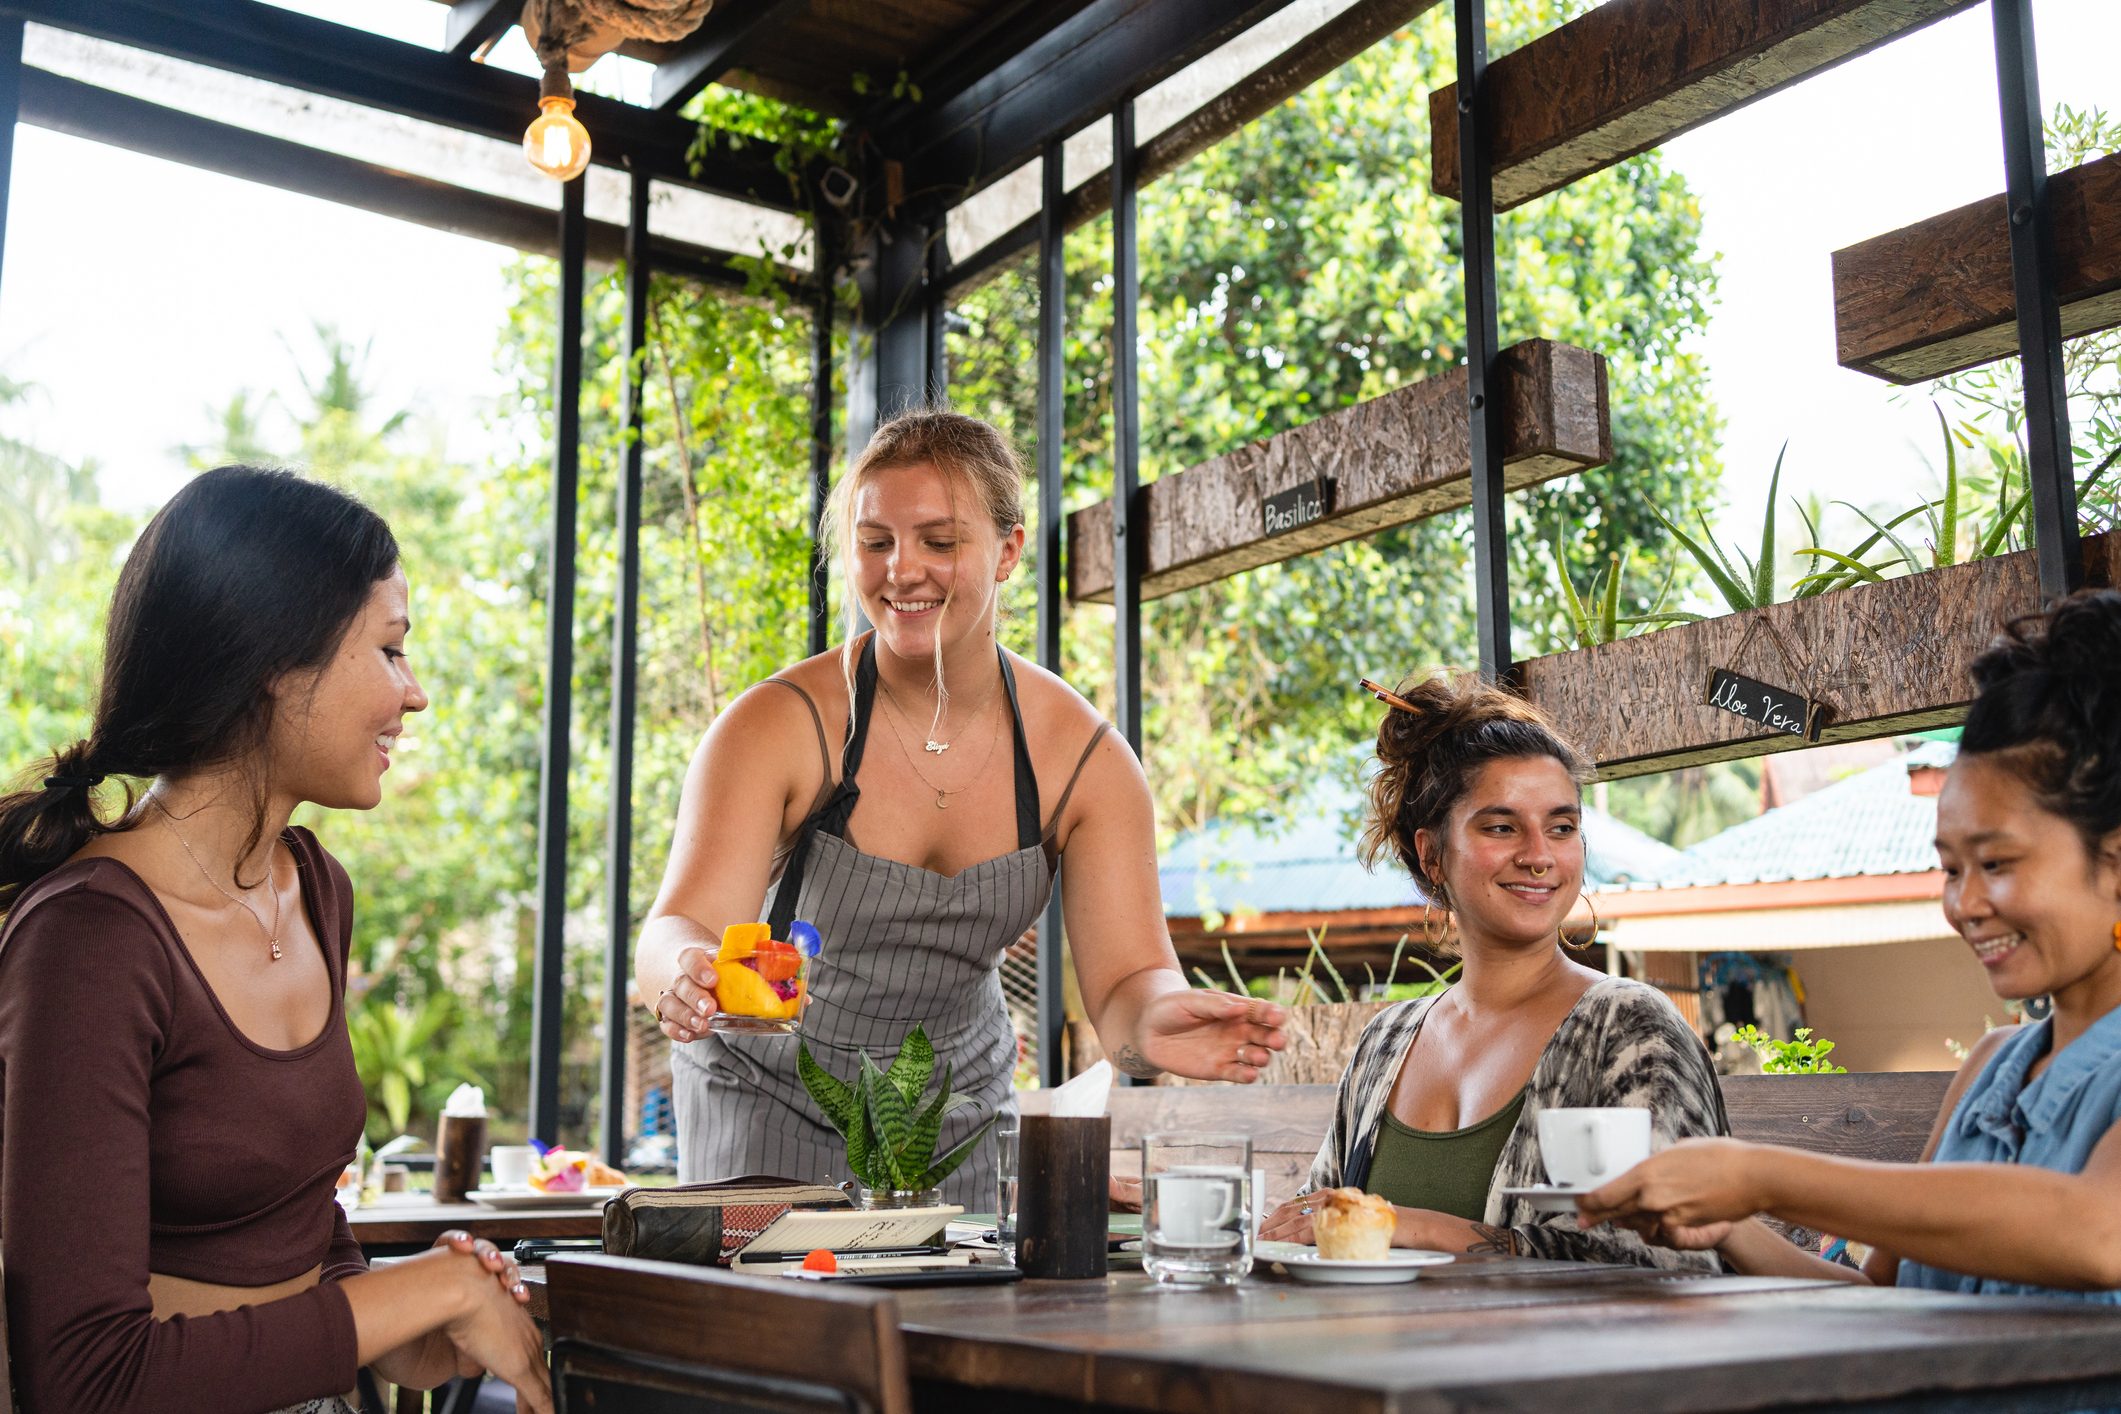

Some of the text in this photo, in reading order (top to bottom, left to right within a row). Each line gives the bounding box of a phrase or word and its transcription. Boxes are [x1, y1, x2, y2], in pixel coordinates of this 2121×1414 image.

[1265, 493, 1322, 534] Basilico
[1709, 677, 1803, 734] Aloe Vera
